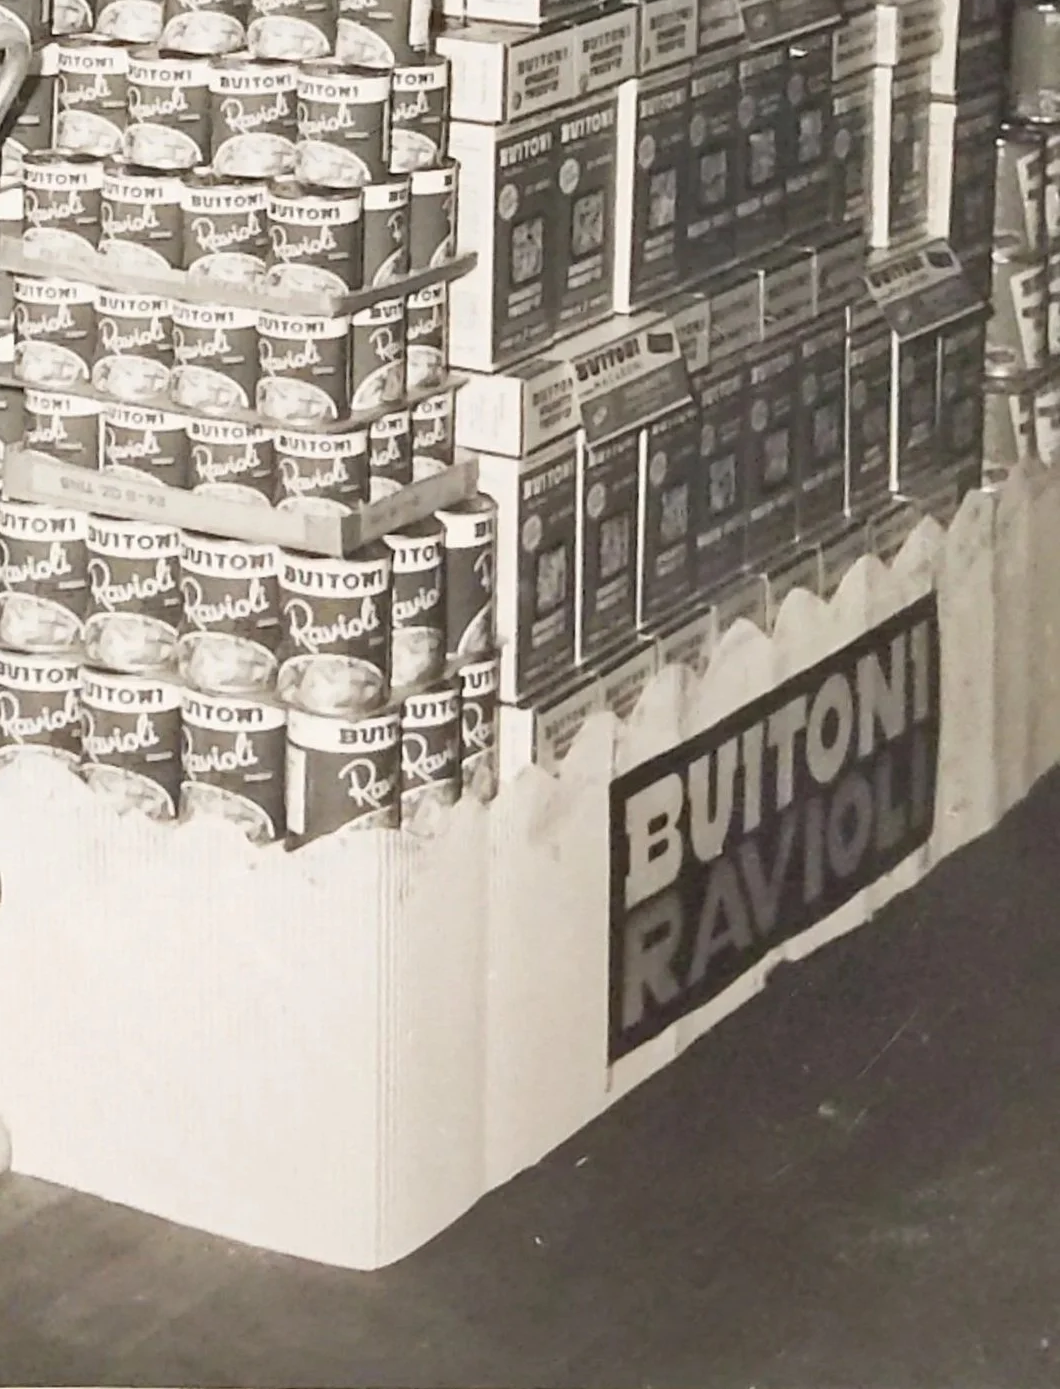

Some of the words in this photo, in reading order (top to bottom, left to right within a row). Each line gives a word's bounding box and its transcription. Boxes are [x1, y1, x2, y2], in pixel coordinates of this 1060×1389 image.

[583, 25, 631, 53] BUITONI
[518, 47, 568, 75] BUITONI
[220, 75, 292, 90] BUITONI
[394, 72, 435, 86] TONI
[220, 92, 291, 134] Ravioli
[561, 108, 614, 143] BUITONI
[499, 132, 553, 166] BUITONI
[191, 192, 264, 208] BUITONI
[270, 202, 341, 220] BUITONI
[191, 213, 262, 254] Ravioli
[268, 224, 337, 264] Ravioli
[99, 295, 169, 313] BUITONI
[99, 315, 165, 356] Ravioli
[575, 338, 640, 382] BUITONI
[32, 396, 71, 411] TONI
[532, 377, 574, 406] BUITON
[191, 438, 262, 483] Ravioli
[279, 434, 352, 453] BUITONI
[278, 456, 350, 496] Ravioli
[88, 557, 175, 612] Ravioli
[284, 564, 383, 590] BUITONI
[181, 576, 270, 631] Ravioli
[393, 586, 440, 629] avio
[283, 595, 380, 654] Ravioli
[338, 721, 399, 744] BUIT
[624, 618, 930, 911] BUITONI
[622, 720, 929, 1029] RAVIOLI
